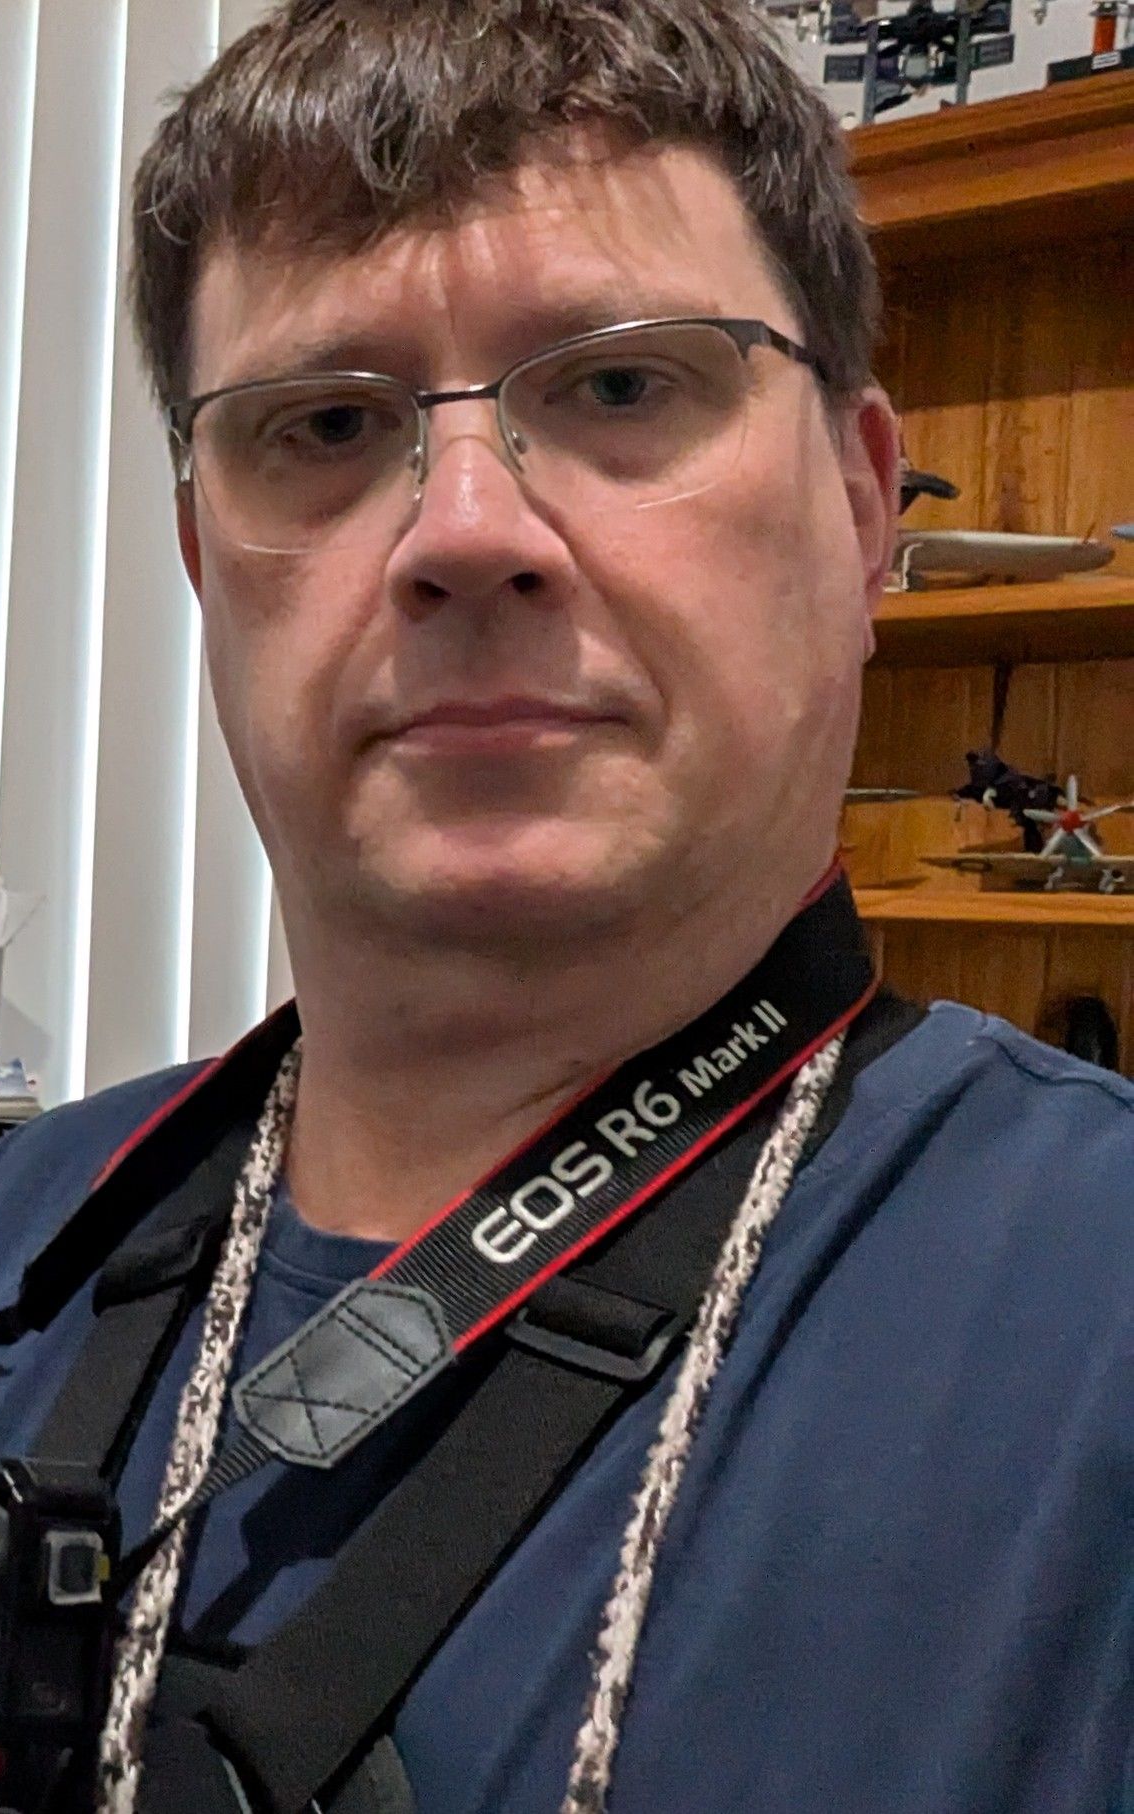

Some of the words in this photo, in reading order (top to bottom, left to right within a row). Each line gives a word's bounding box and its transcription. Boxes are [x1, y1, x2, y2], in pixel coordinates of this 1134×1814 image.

[471, 1140, 614, 1264] EOS
[594, 1080, 681, 1158] R6
[677, 1021, 769, 1098] Mark
[751, 999, 788, 1034] II
